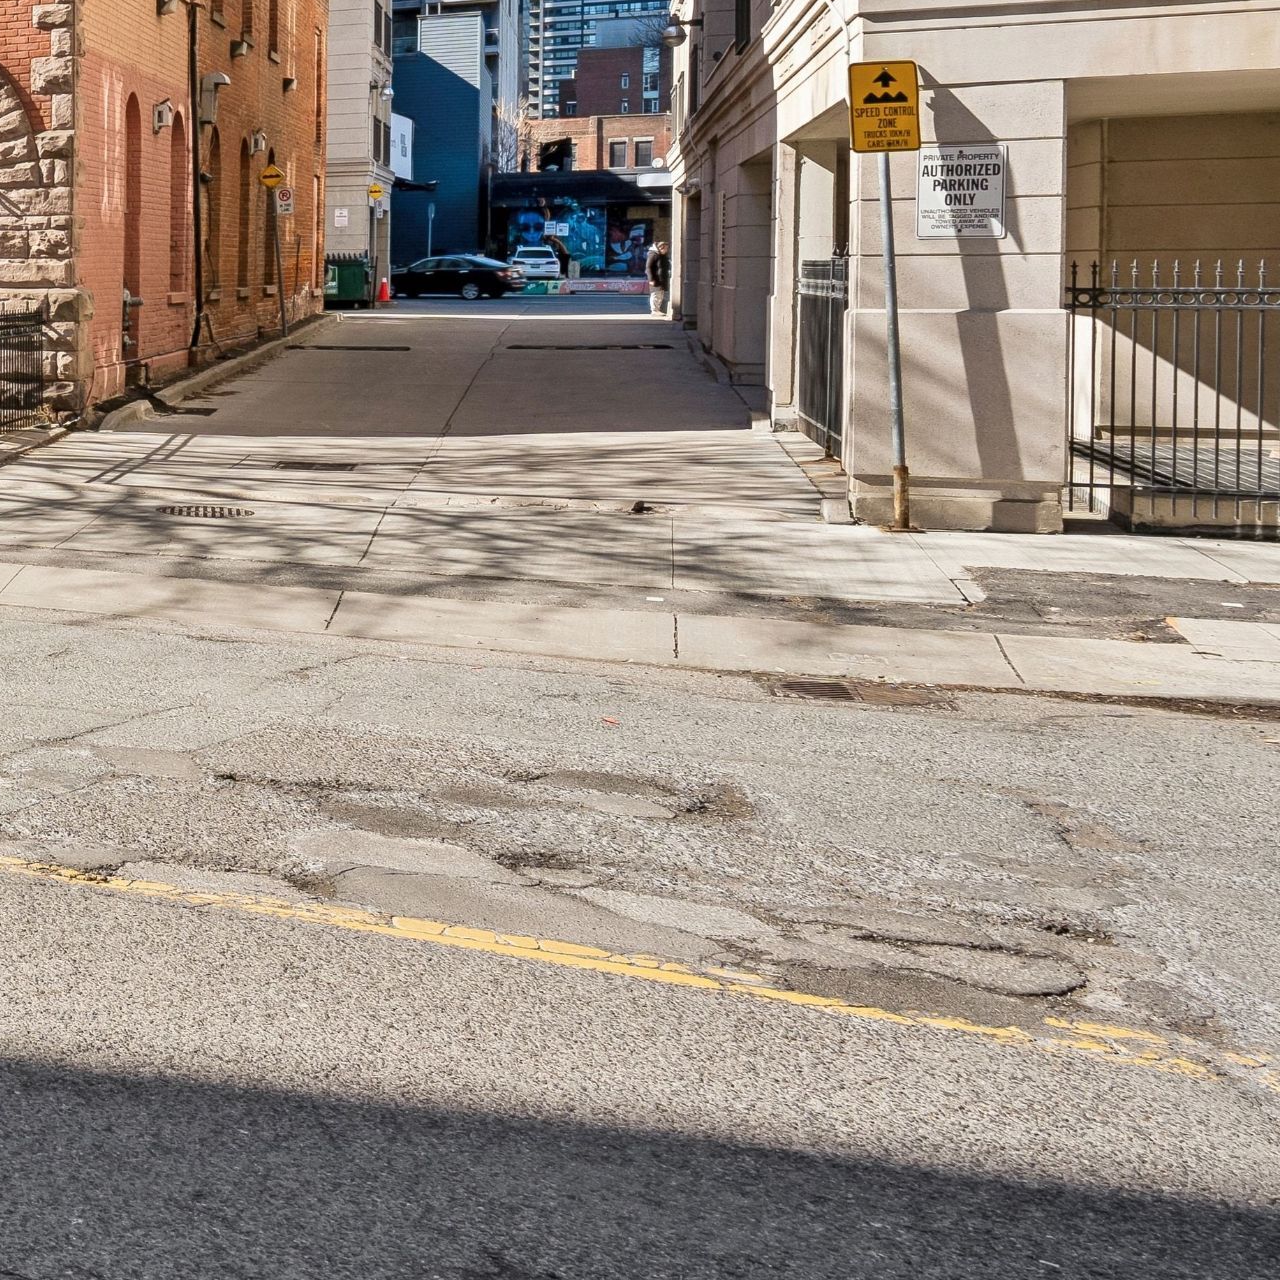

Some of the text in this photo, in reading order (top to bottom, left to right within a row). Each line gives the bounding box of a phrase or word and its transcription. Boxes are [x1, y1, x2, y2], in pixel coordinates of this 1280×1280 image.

[854, 106, 916, 118] SPEED CONTROL
[878, 118, 897, 128] ZONE
[864, 130, 887, 138] TRUCKS
[867, 140, 884, 148] CARS
[922, 164, 1000, 177] AUTHORIZED
[932, 178, 989, 192] PARKING
[945, 193, 976, 206] ONLY
